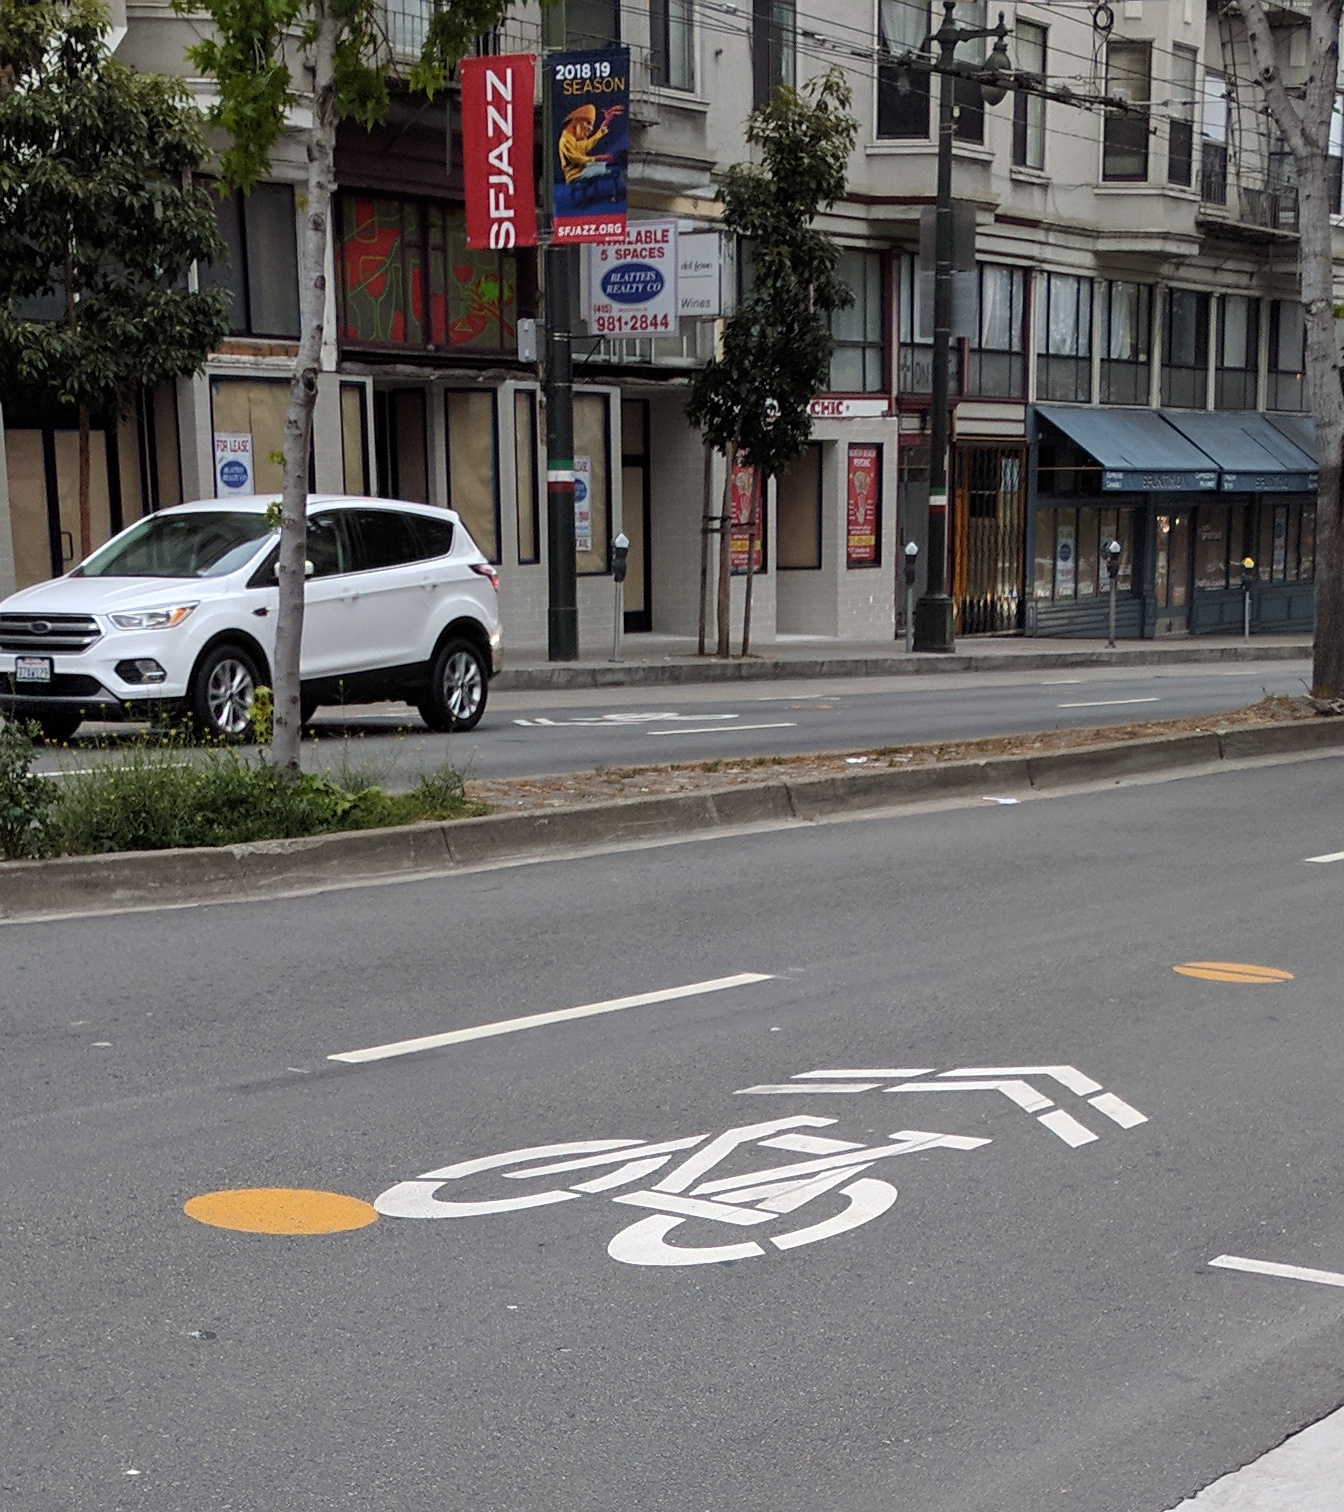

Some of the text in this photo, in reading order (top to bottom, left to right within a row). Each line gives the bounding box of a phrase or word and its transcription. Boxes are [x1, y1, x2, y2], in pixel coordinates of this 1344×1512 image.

[556, 62, 611, 80] 2018 19
[563, 76, 625, 95] SEASON
[485, 67, 516, 250] SFJAZZ
[557, 223, 623, 237] SFJAZZ.ORG
[600, 246, 665, 261] 5 SPACES
[610, 271, 657, 283] BLATTEIS
[606, 281, 662, 295] REALTY CO
